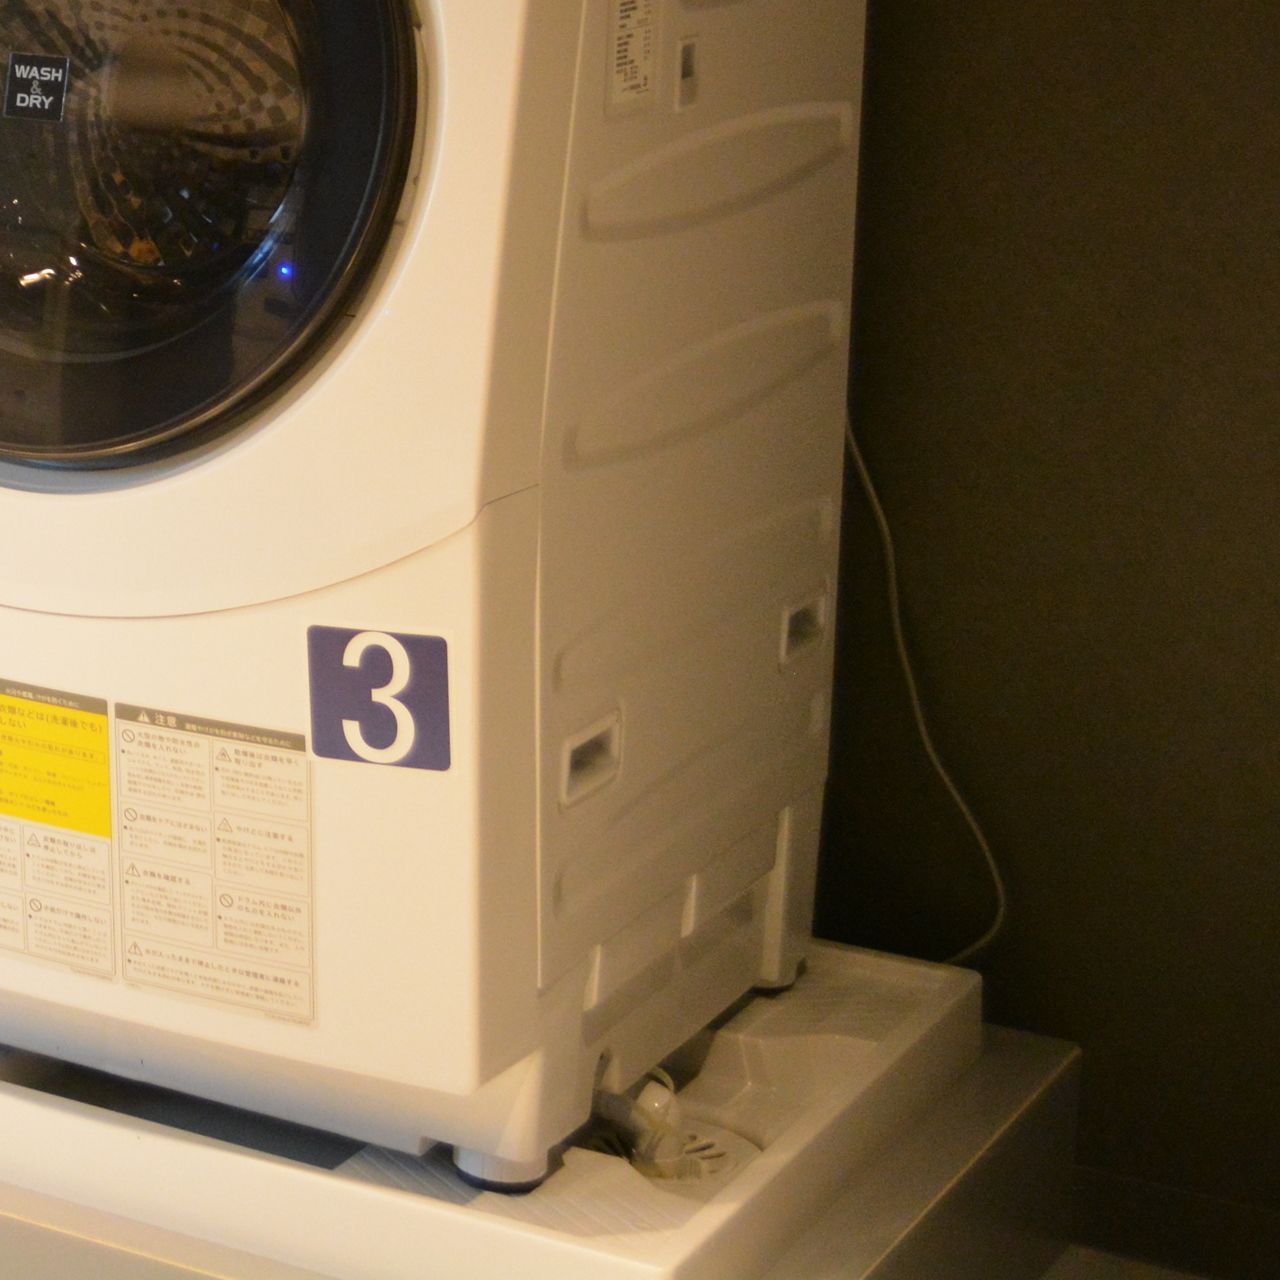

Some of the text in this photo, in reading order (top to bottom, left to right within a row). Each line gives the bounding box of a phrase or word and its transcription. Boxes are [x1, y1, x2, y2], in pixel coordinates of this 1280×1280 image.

[14, 64, 62, 82] WASH
[30, 80, 42, 95] &
[15, 93, 54, 110] DRY
[342, 630, 416, 764] 3
[153, 711, 177, 729] 注意
